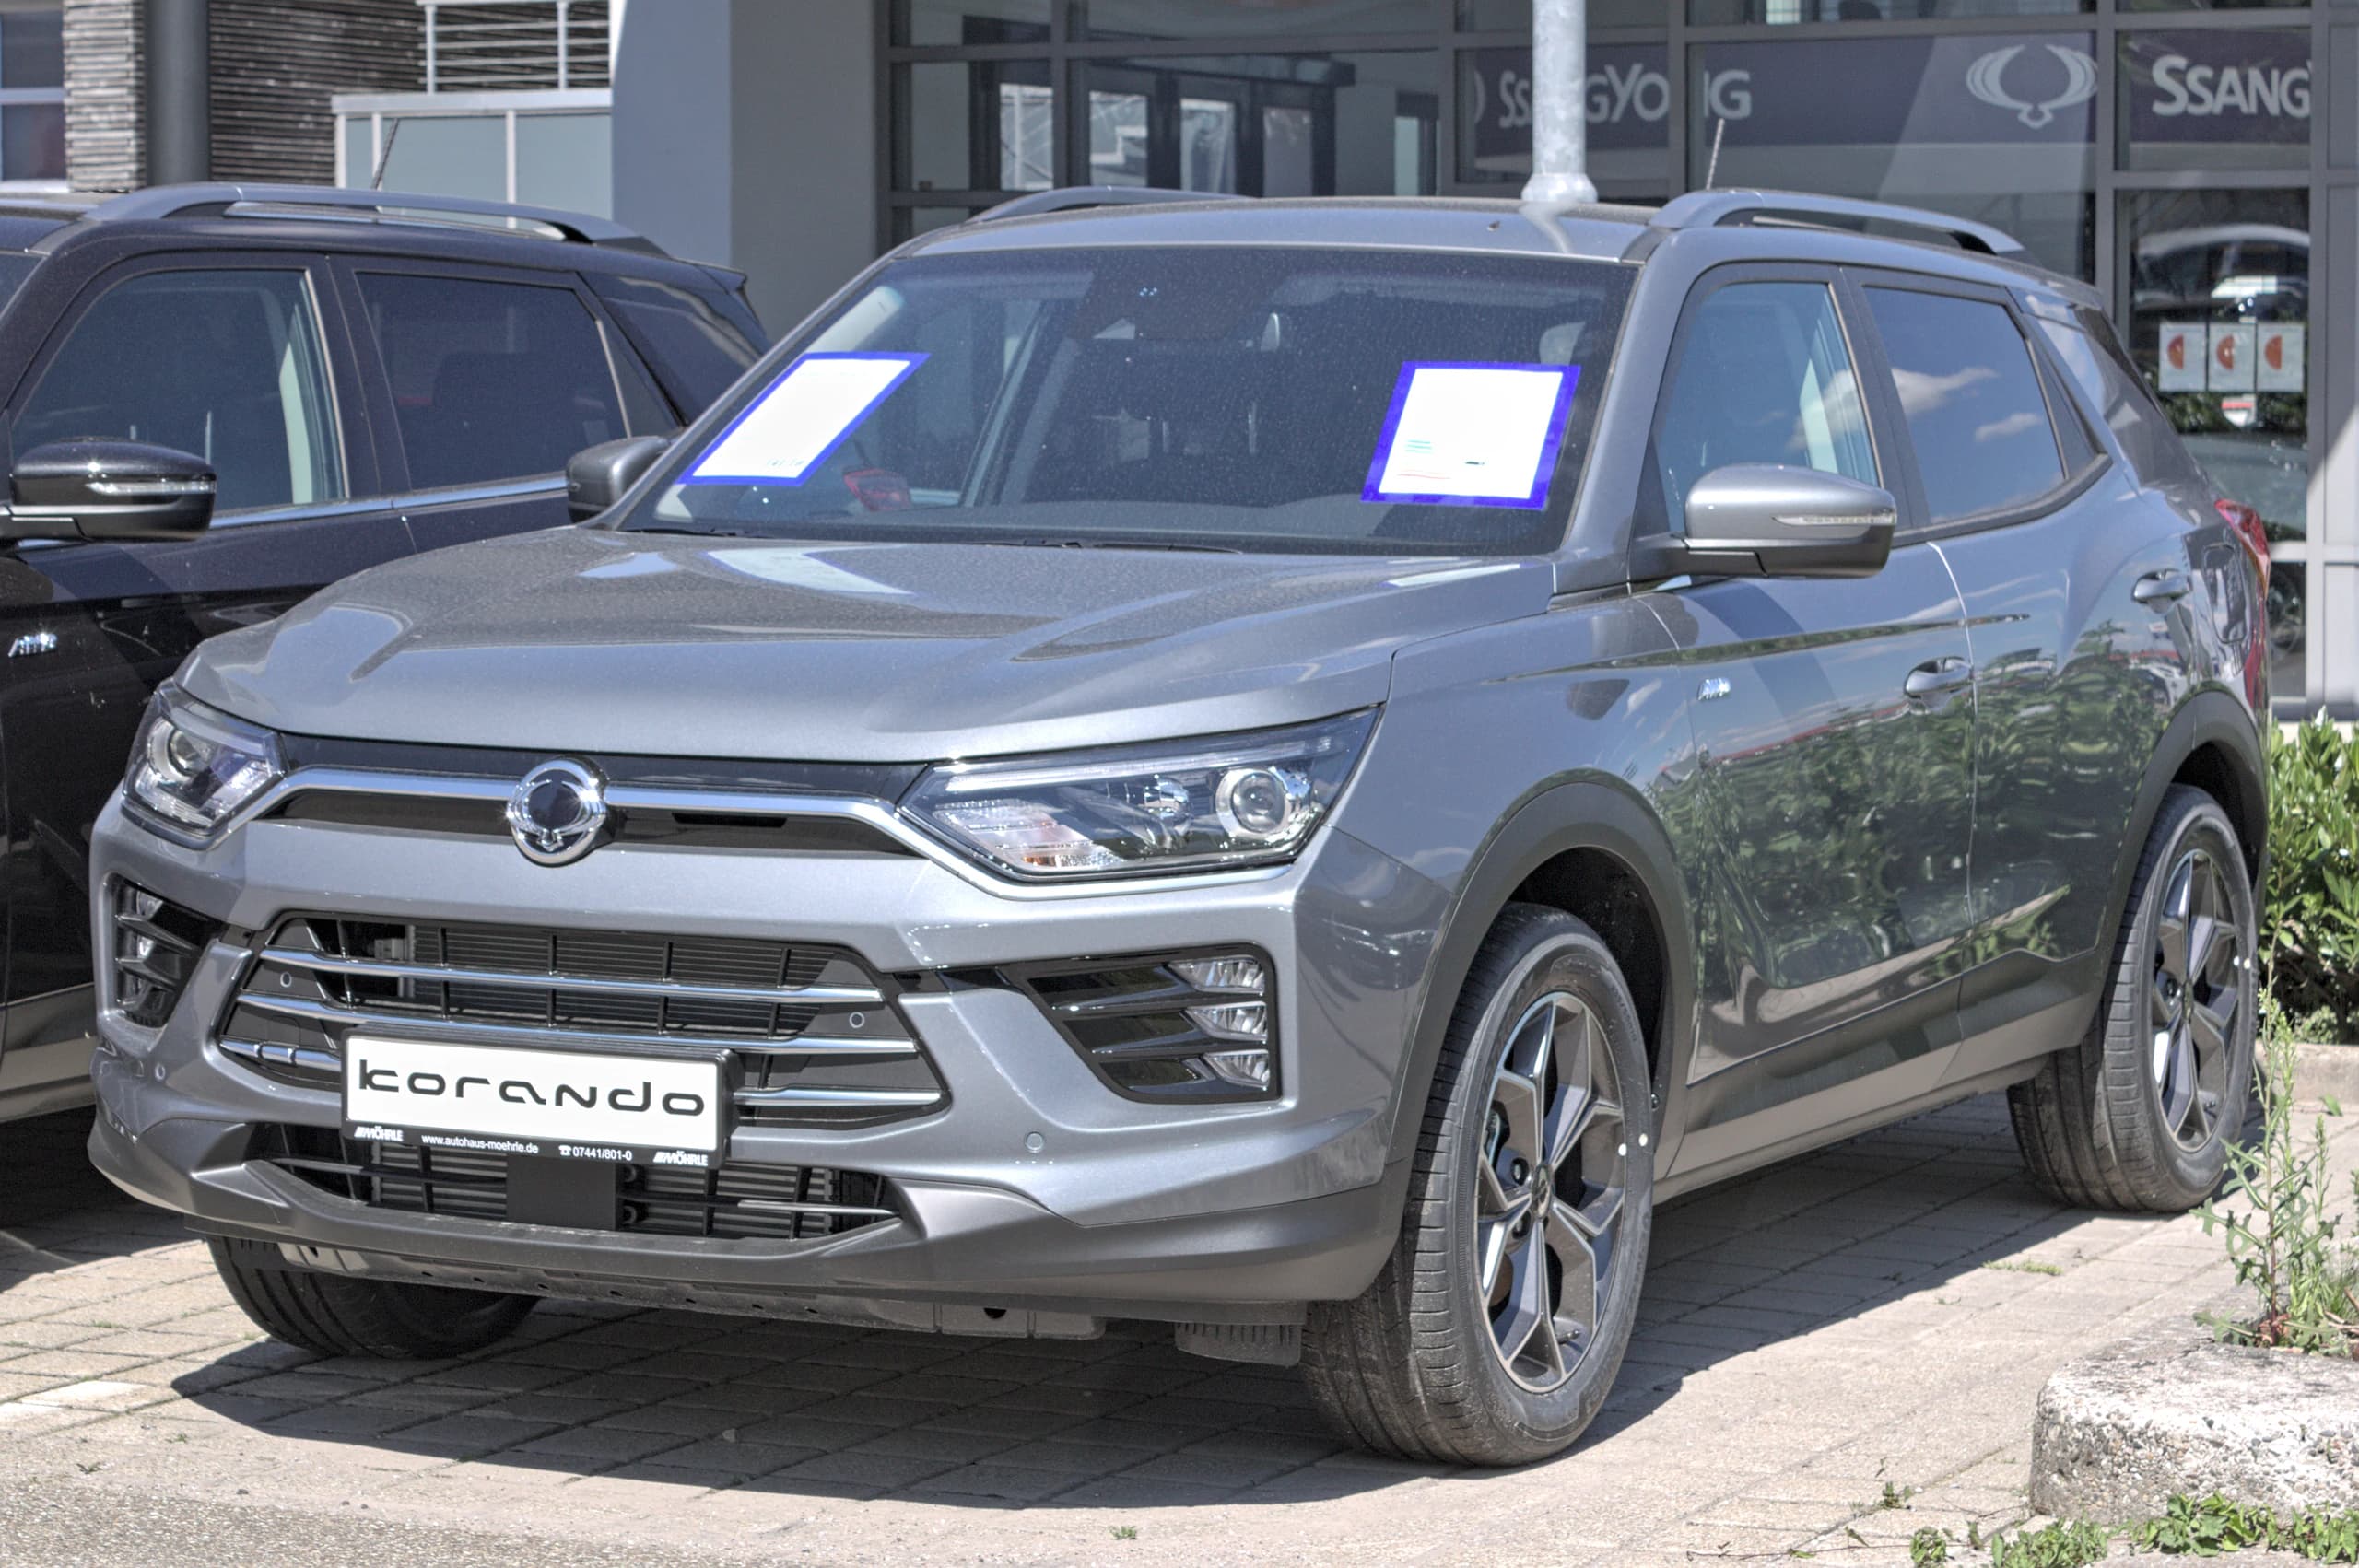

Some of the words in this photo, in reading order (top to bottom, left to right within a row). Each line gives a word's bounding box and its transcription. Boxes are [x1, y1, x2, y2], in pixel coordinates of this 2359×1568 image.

[358, 1059, 705, 1117] korando
[421, 1135, 539, 1153] www.autohaus-moehrle.de
[572, 1146, 632, 1161] 07441/801-0
